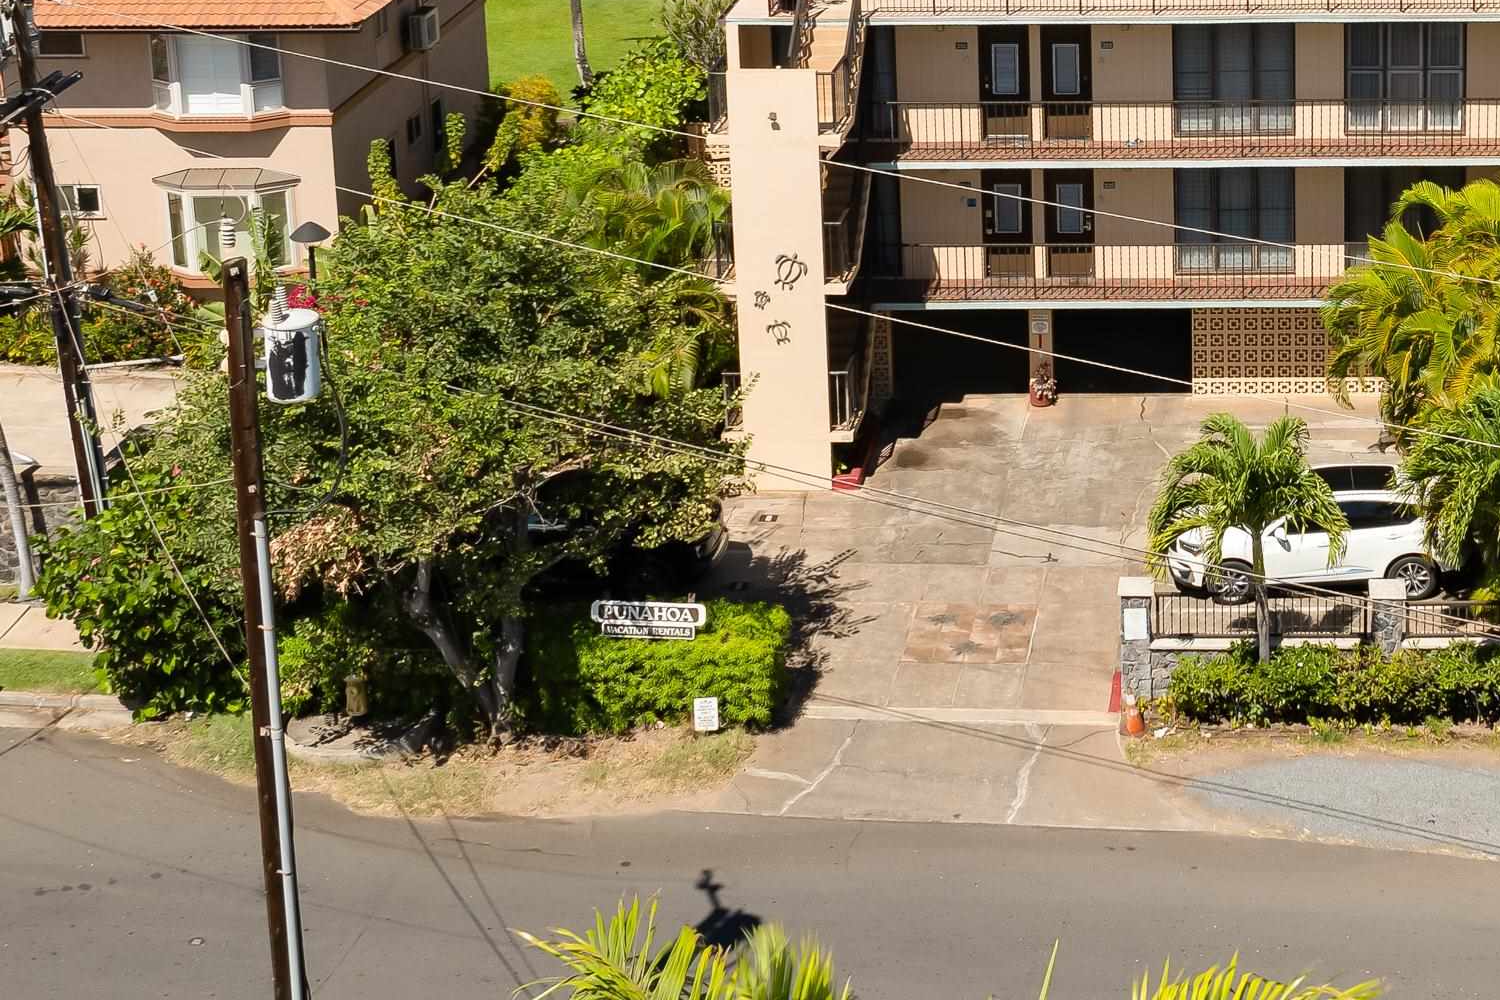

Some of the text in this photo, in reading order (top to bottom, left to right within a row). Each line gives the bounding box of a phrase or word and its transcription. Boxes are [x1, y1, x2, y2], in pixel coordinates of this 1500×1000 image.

[603, 605, 694, 622] PUNAHOA
[606, 625, 691, 636] VACATION RENTALS
